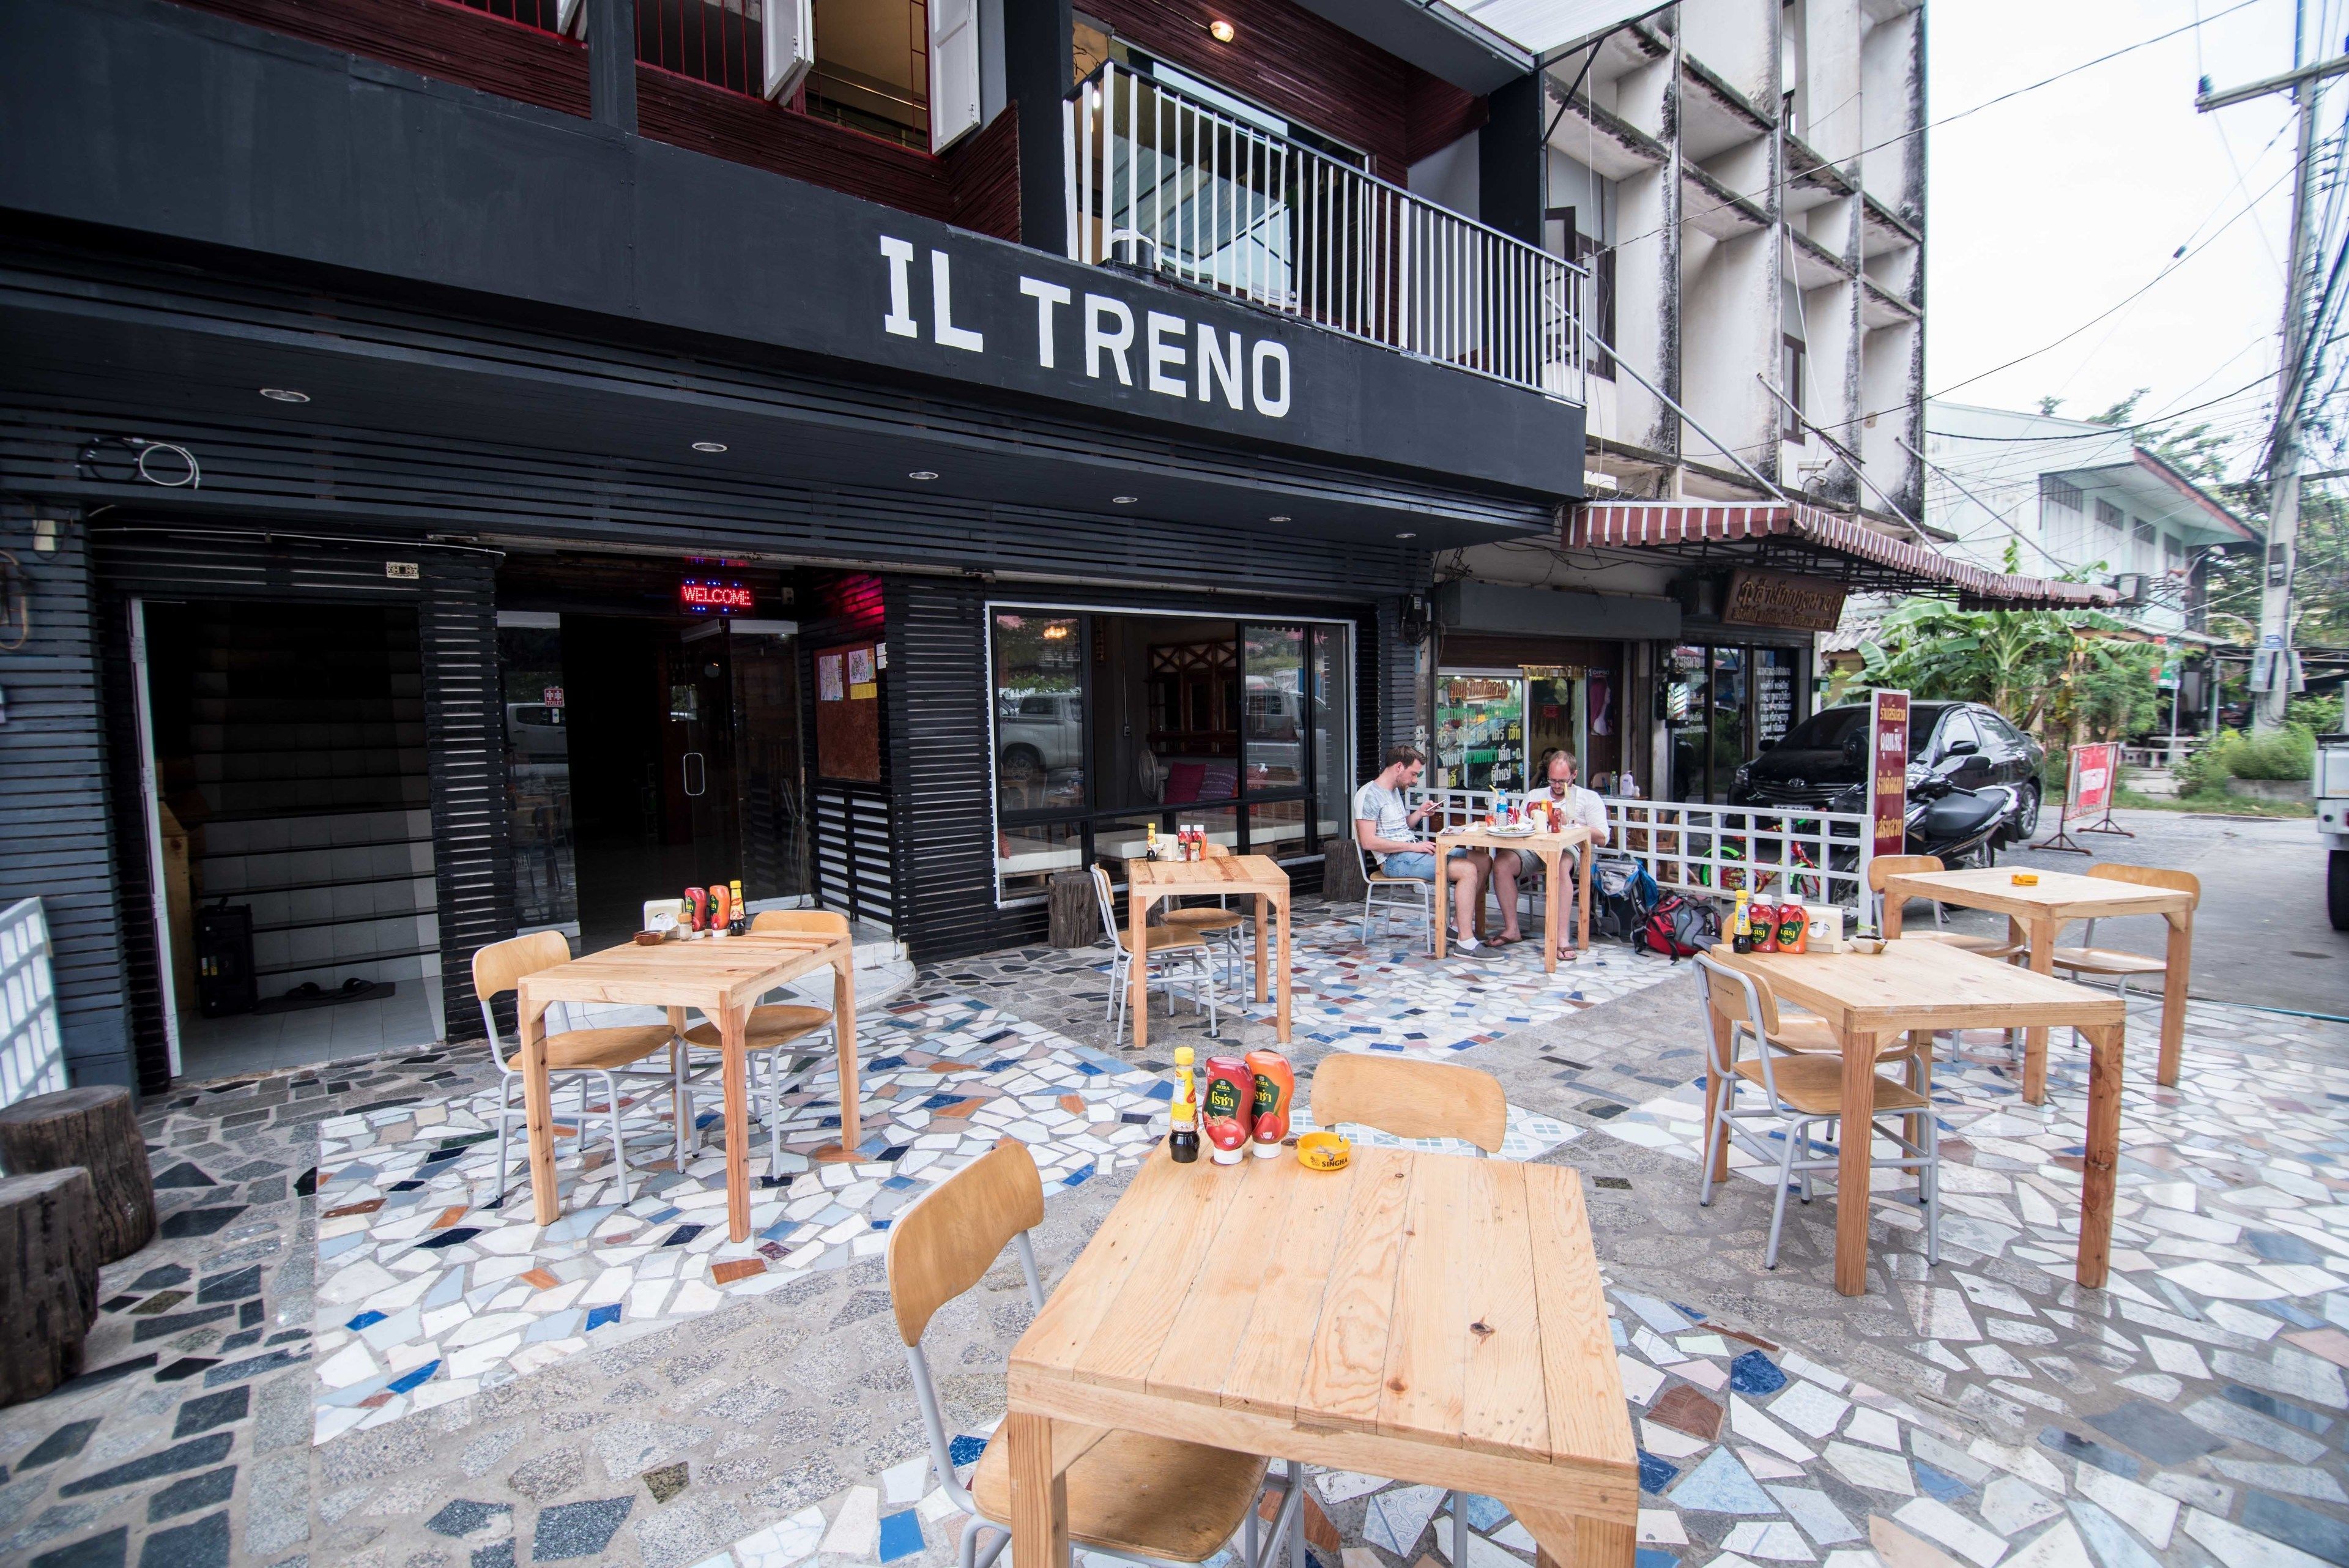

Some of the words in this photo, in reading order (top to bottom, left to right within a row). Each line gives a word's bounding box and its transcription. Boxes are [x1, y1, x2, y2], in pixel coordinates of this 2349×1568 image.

[880, 235, 983, 353] IL
[1020, 276, 1291, 418] TRENO
[682, 585, 752, 606] WELCOME
[1212, 1091, 1234, 1107] โรซ่า
[1321, 1157, 1348, 1167] SINGHA
